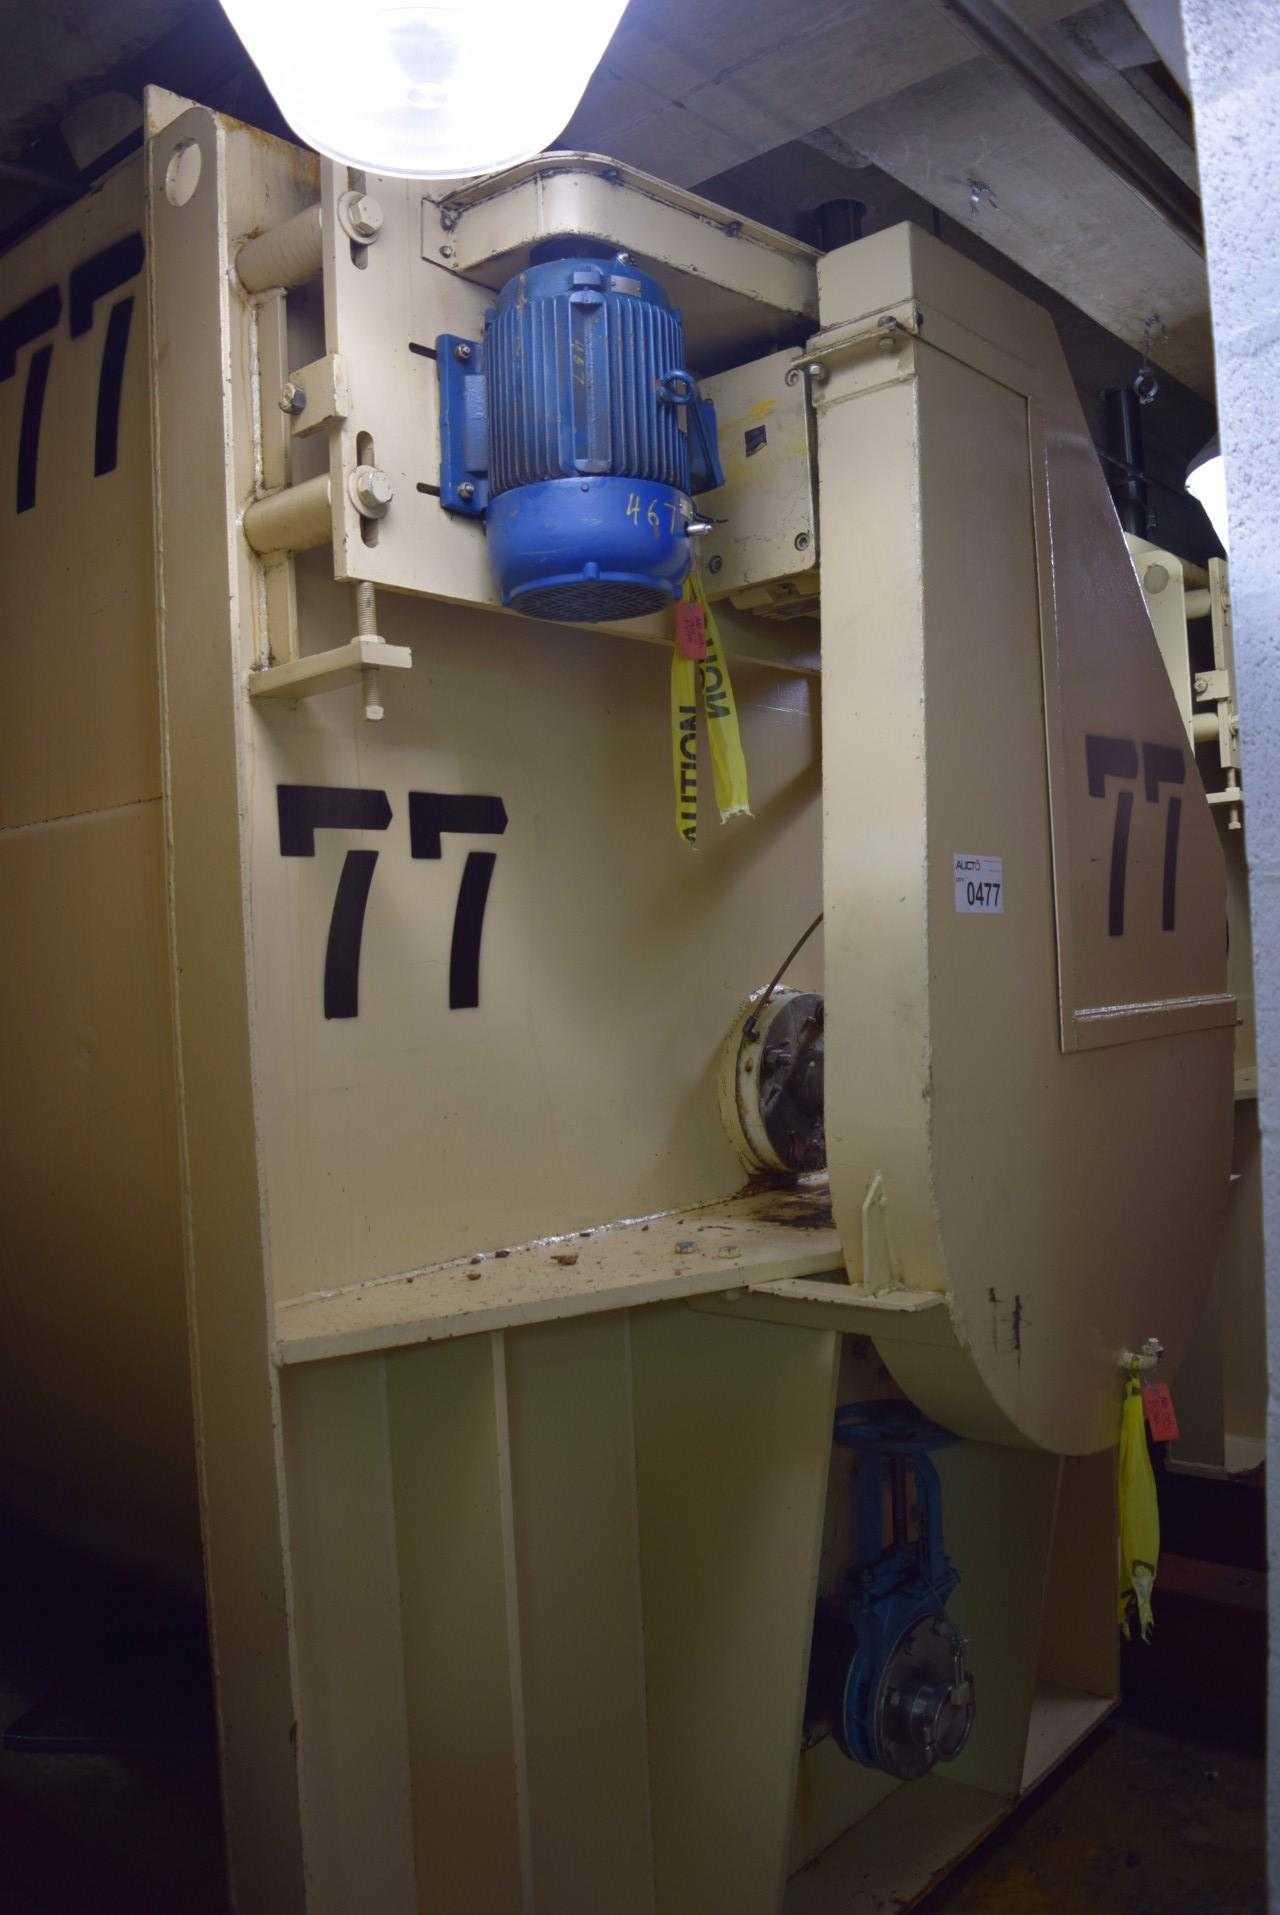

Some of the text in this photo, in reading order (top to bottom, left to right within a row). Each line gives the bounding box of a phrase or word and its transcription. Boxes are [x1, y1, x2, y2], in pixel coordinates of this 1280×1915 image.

[0, 231, 145, 513] 77
[277, 786, 507, 1019] 77
[967, 882, 1000, 907] 0477
[1086, 734, 1187, 938] 77
